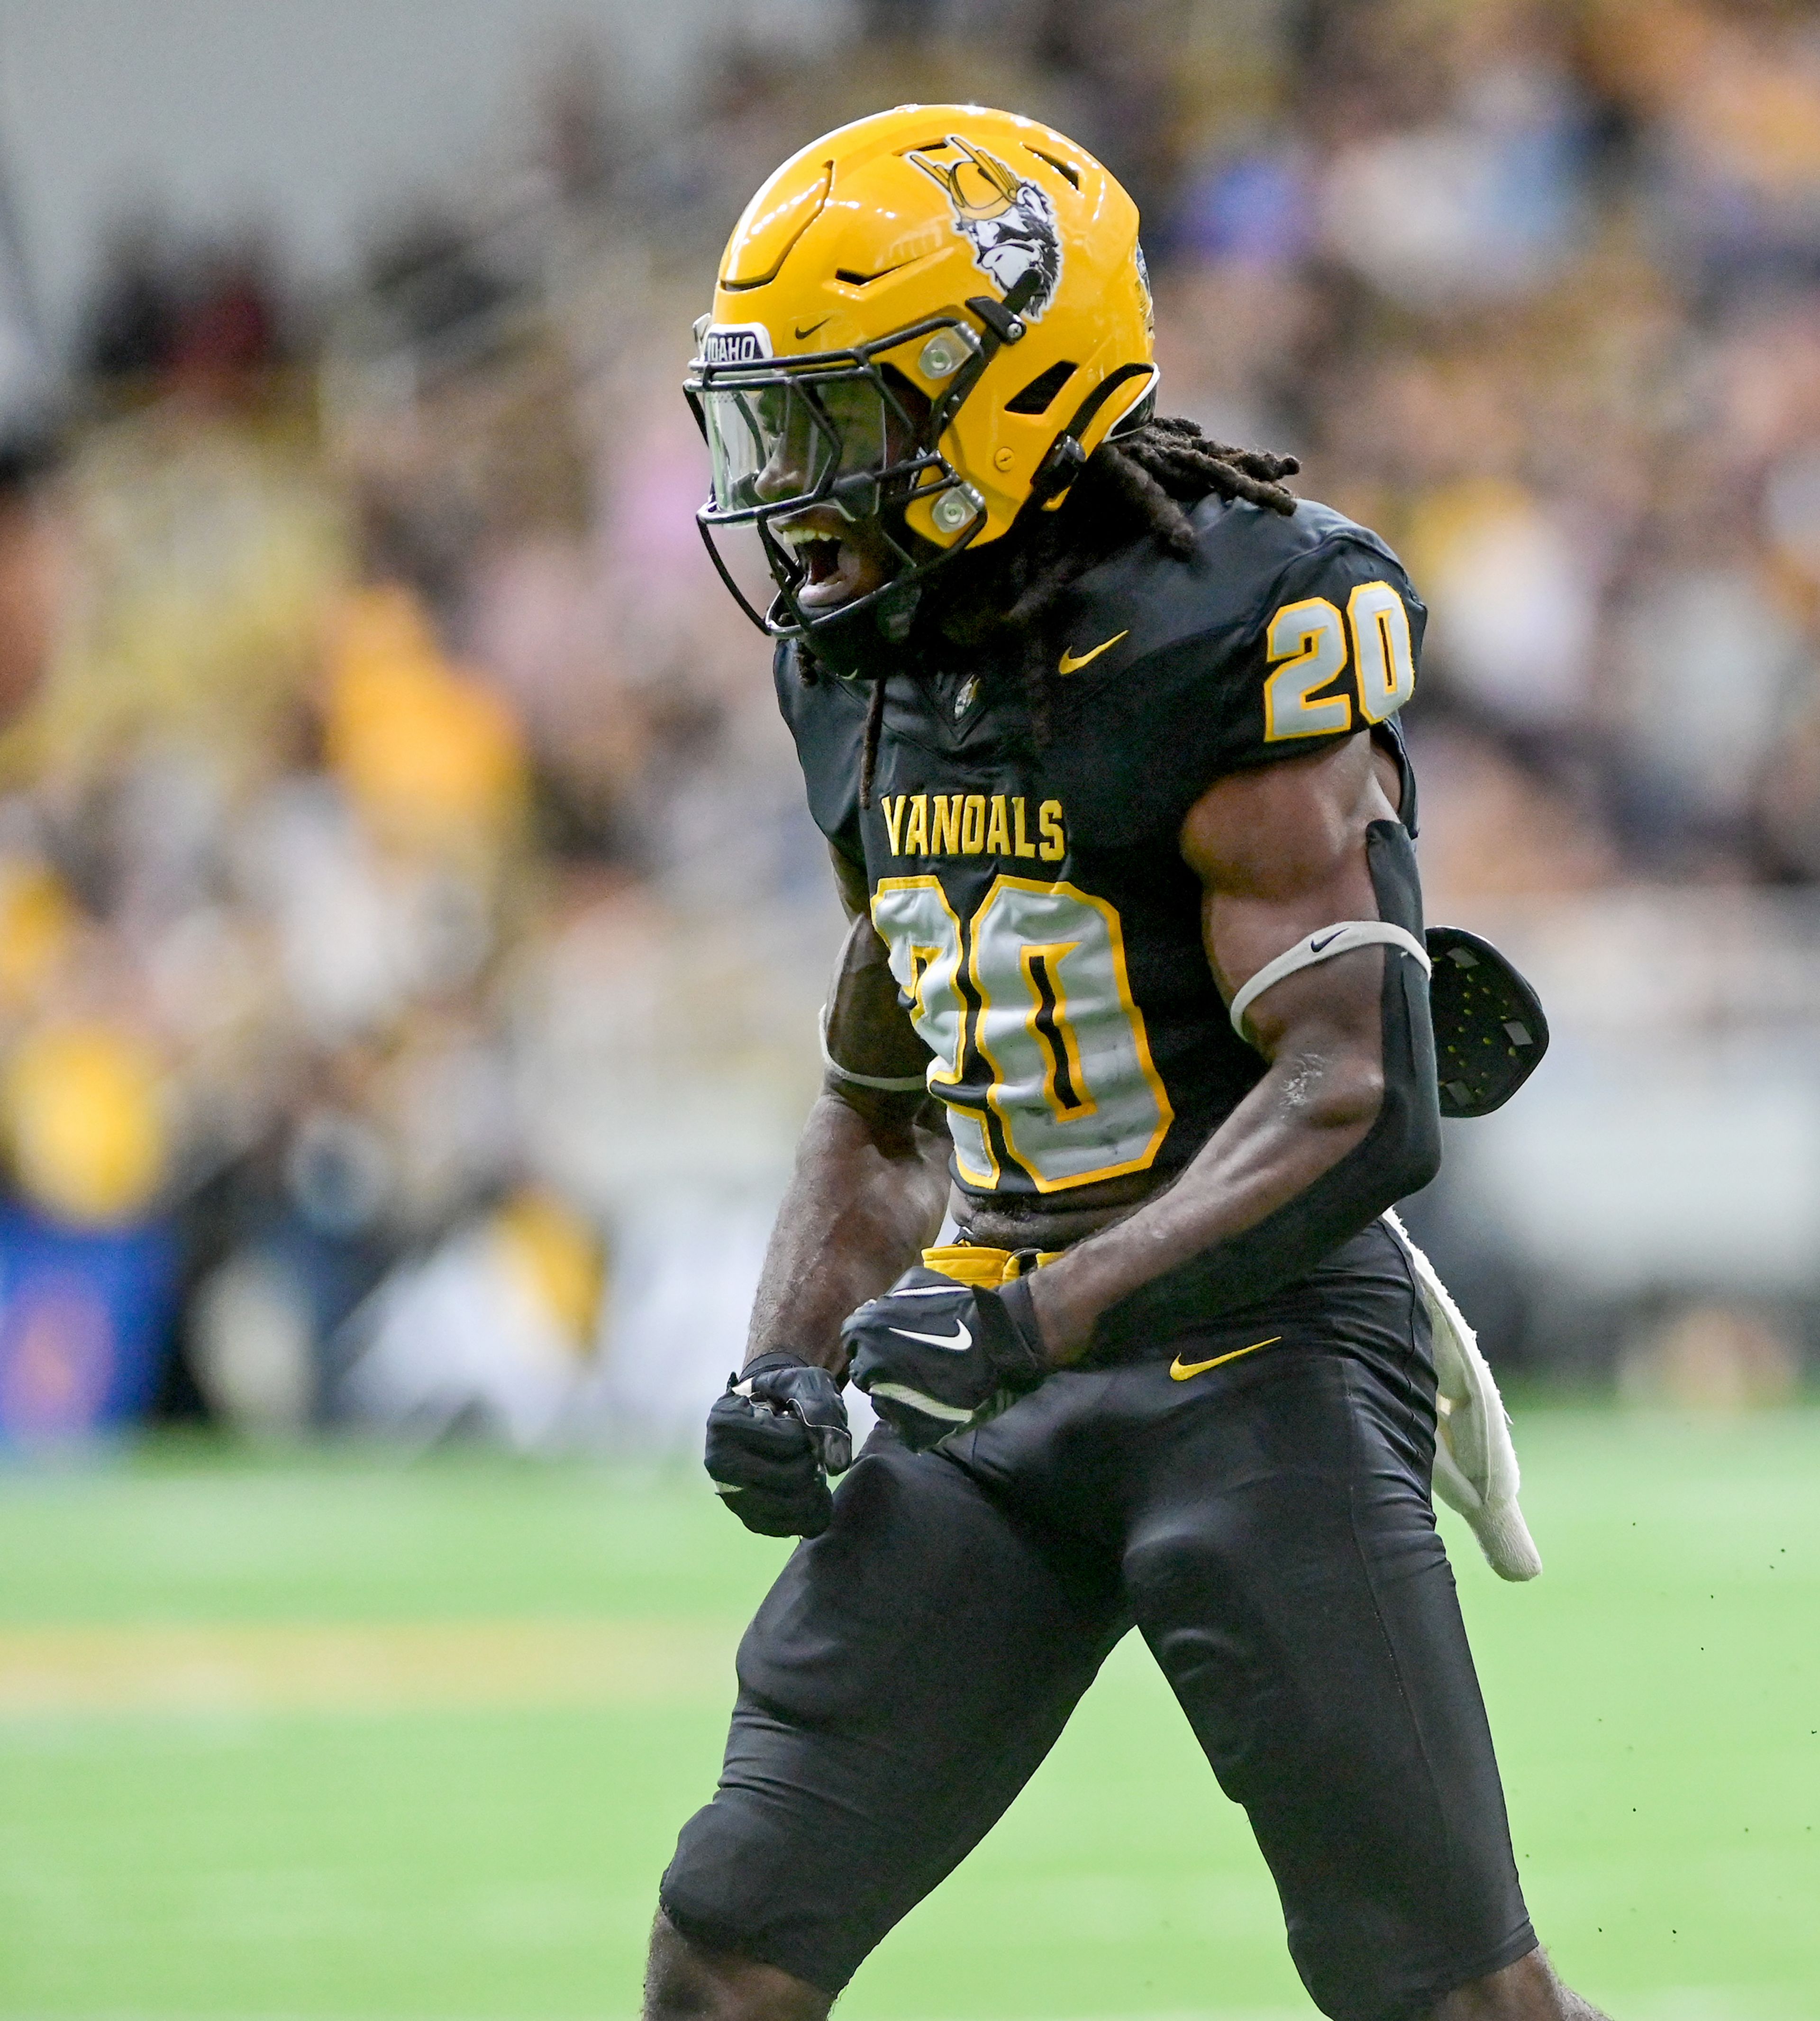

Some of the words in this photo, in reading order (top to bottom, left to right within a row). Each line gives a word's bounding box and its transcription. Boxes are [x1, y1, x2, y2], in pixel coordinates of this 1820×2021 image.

[708, 336, 756, 362] IDAHO
[1264, 580, 1415, 743] 20
[881, 794, 1065, 861] VANDALS
[870, 873, 1174, 1193] 20
